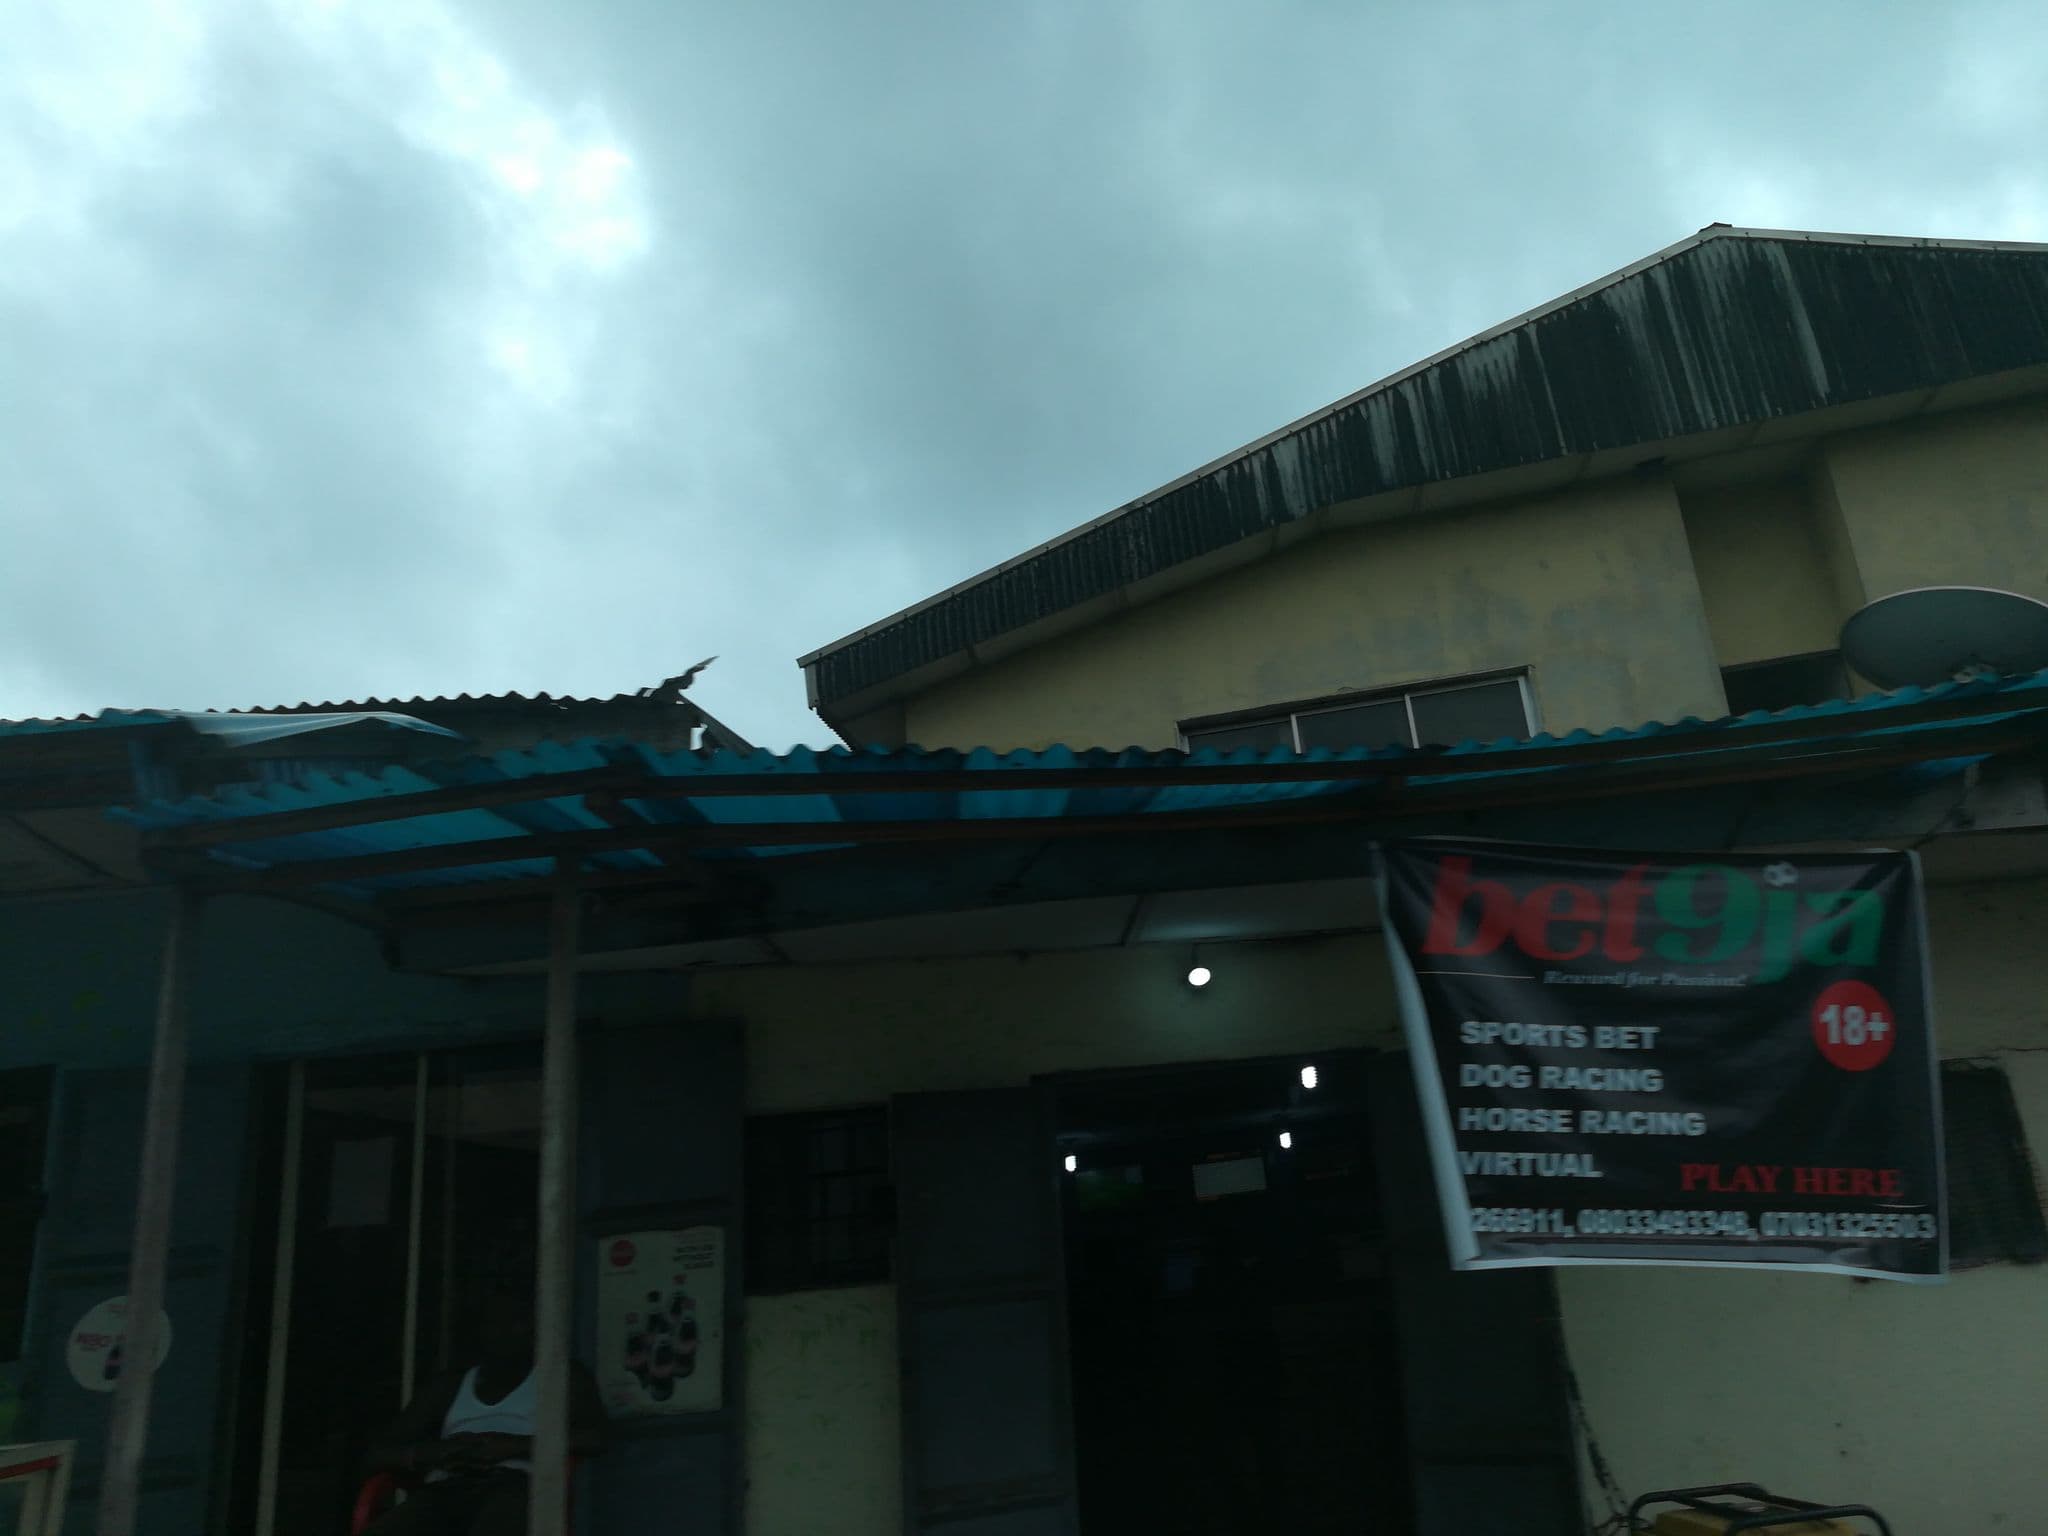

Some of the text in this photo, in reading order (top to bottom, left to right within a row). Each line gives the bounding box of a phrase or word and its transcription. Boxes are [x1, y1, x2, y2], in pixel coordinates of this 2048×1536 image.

[1421, 855, 1886, 985] bet9ja
[1459, 1020, 1661, 1050] SPORTS BET
[1820, 1004, 1890, 1046] 18+
[1459, 1063, 1665, 1093] DOG RACING
[1458, 1106, 1707, 1137] HORSE RACING
[1459, 1151, 1605, 1179] VIRTUAL
[1679, 1163, 1905, 1198] PLAY HERE
